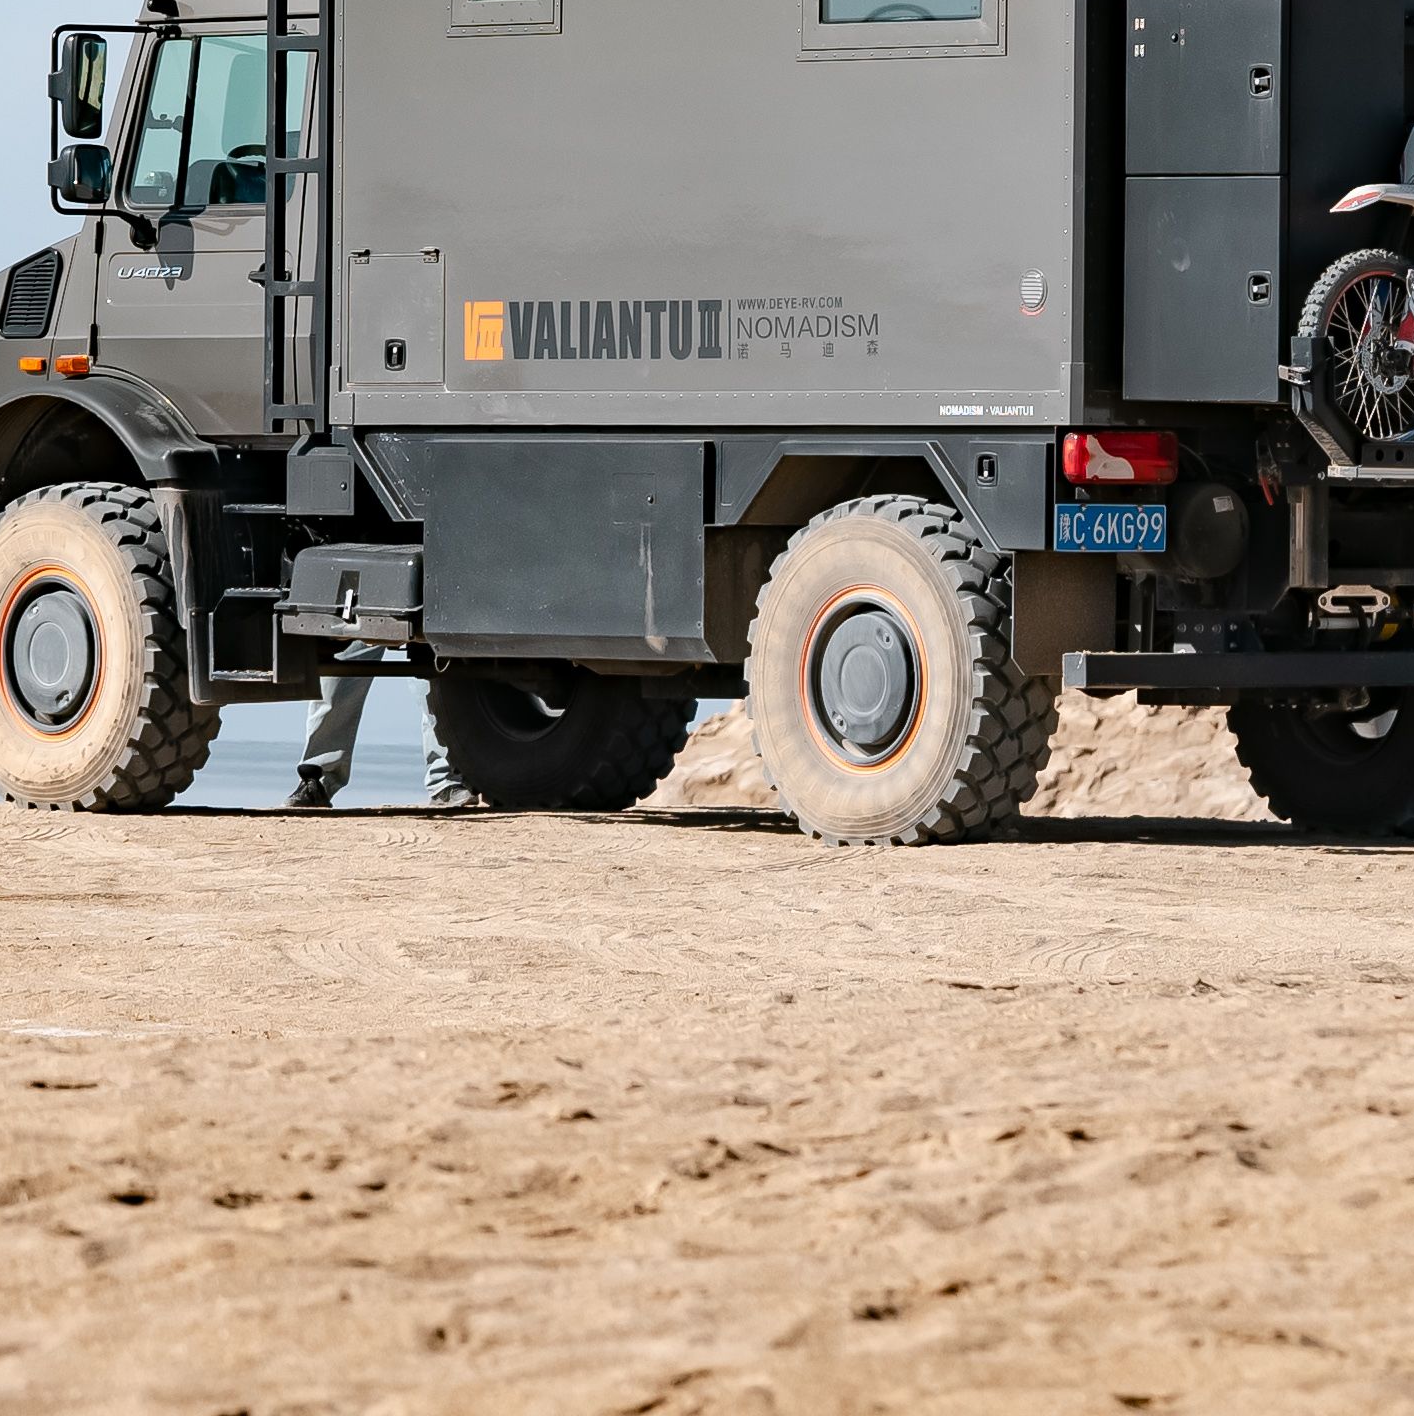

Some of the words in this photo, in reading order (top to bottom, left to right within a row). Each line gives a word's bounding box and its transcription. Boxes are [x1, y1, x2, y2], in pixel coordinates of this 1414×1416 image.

[117, 266, 183, 279] U4023
[737, 313, 879, 339] NOMADISM
[939, 405, 984, 416] NOMADISM
